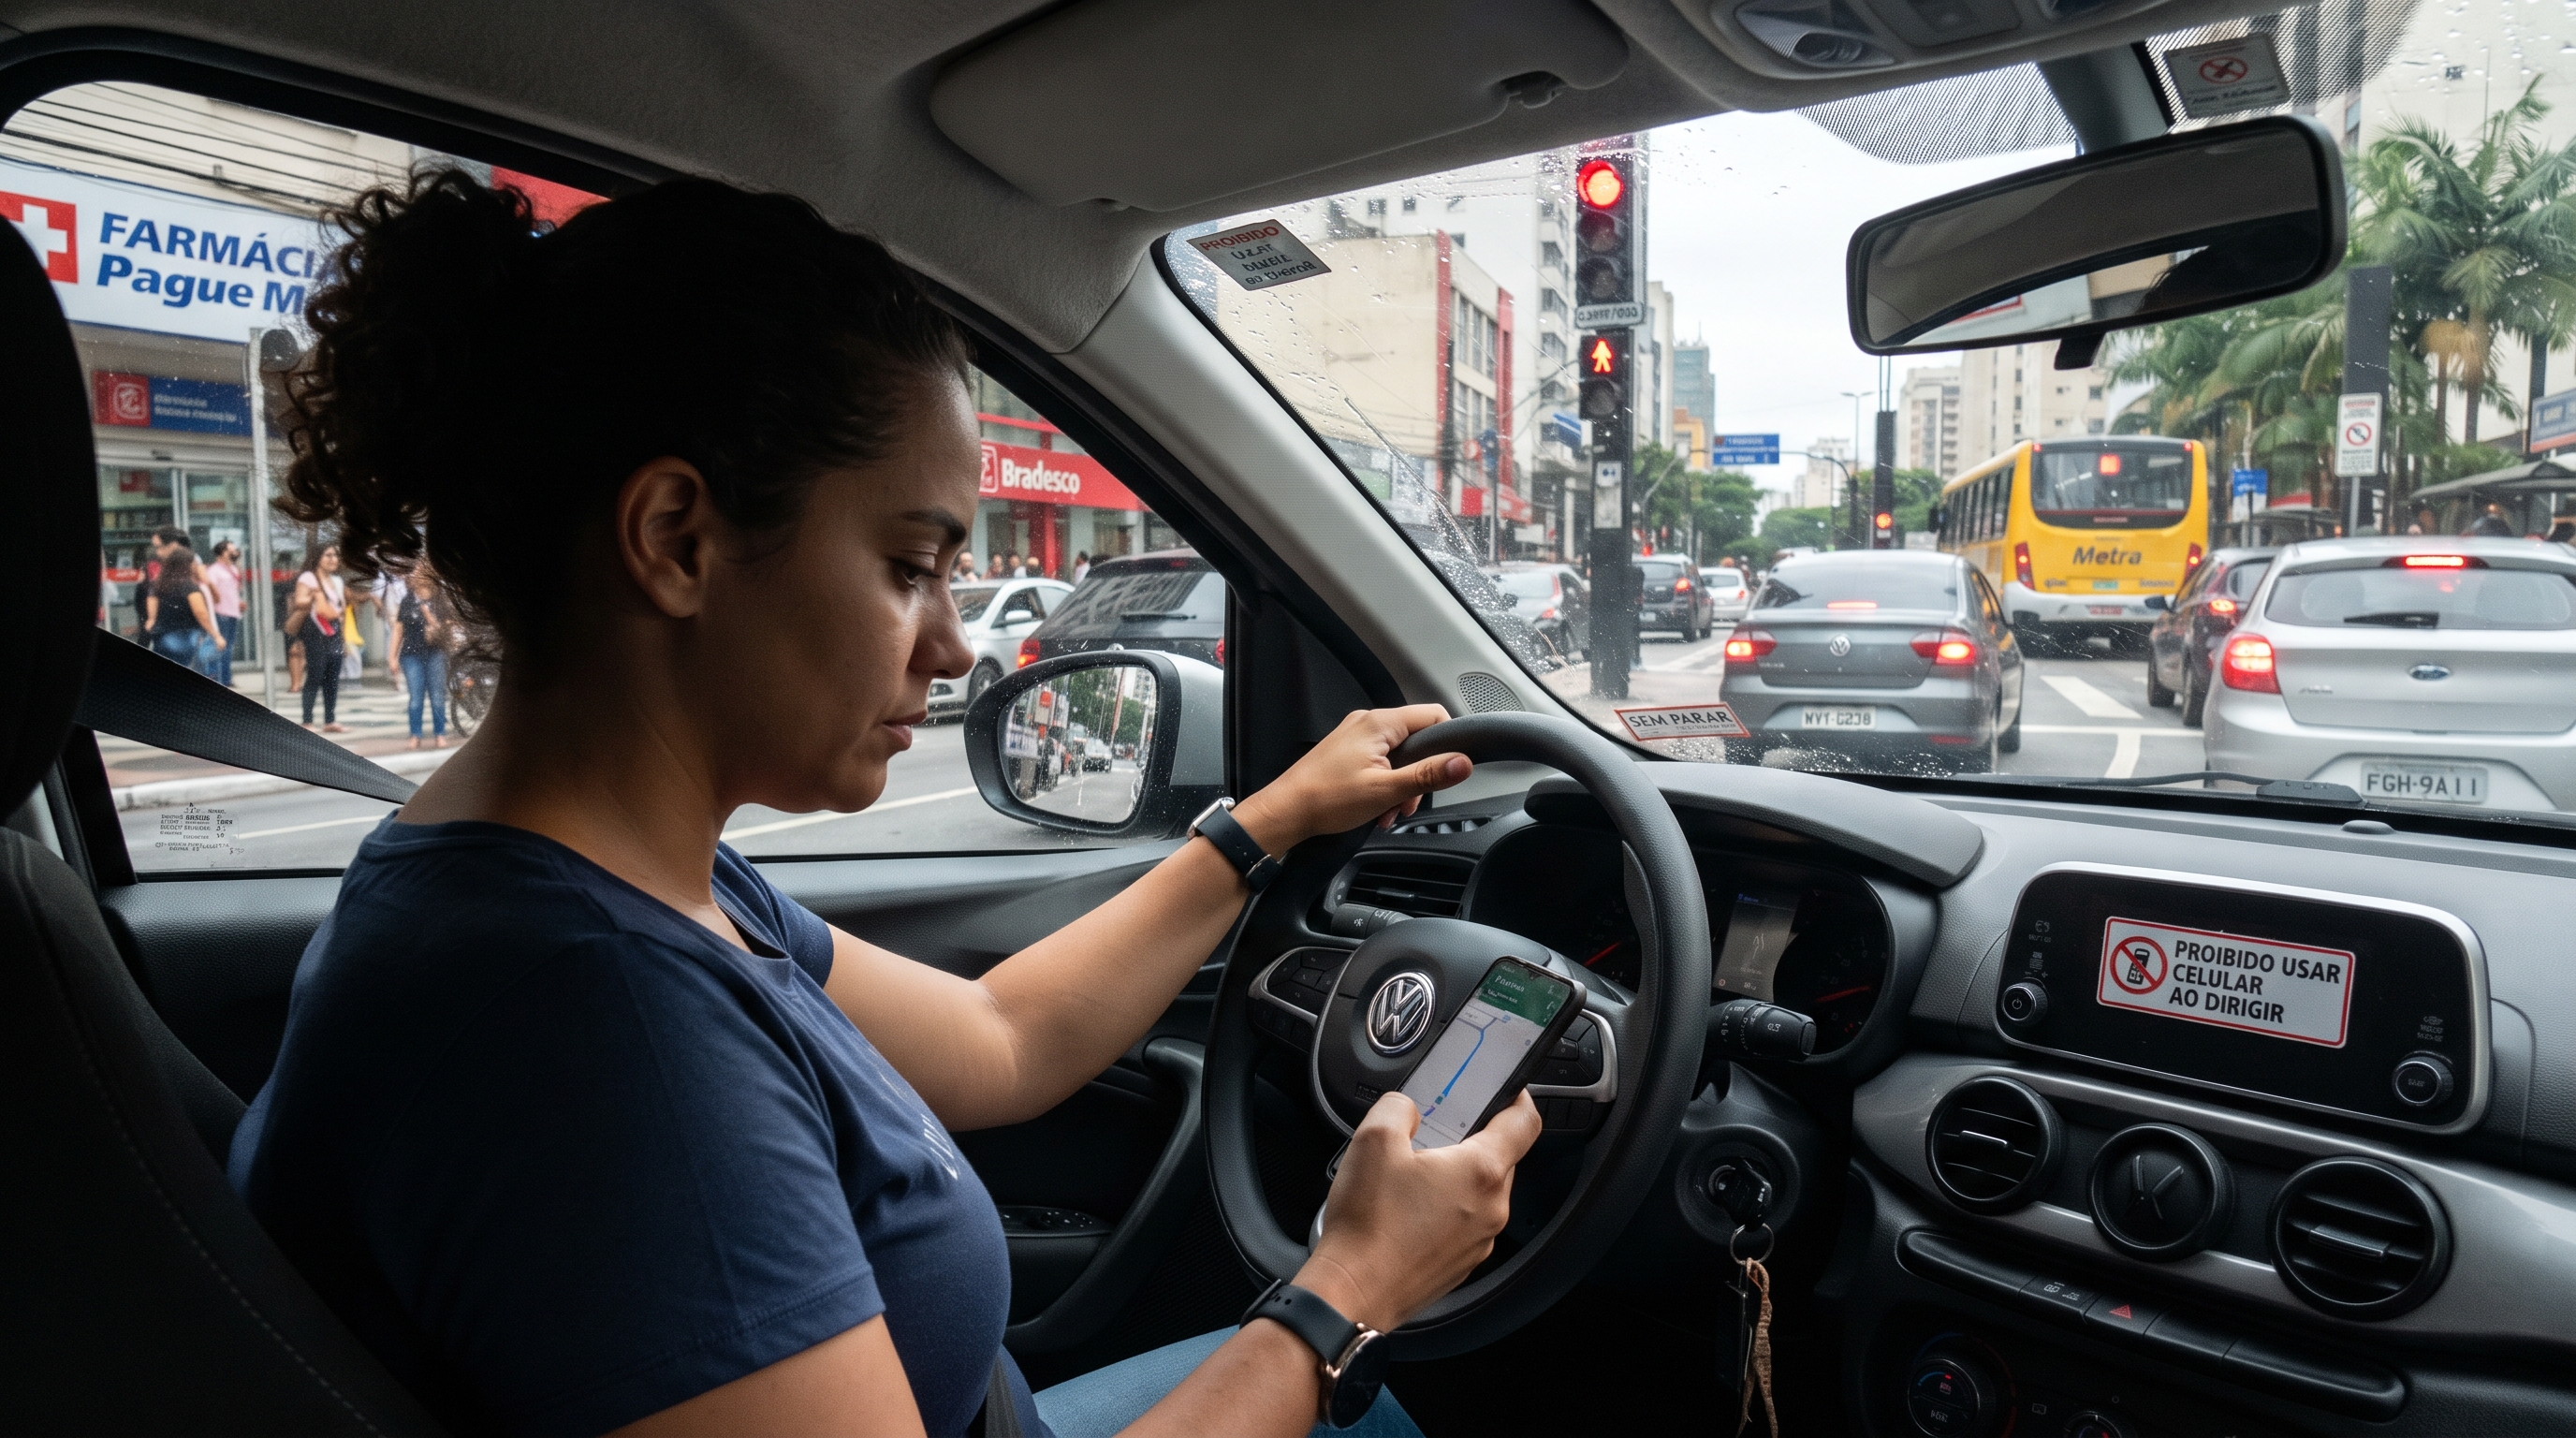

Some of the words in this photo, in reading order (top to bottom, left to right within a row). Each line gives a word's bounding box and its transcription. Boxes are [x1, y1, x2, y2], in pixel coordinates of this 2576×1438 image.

[1199, 226, 1280, 251] PROIBIDO
[96, 253, 254, 309] Pague
[263, 280, 307, 315] M
[1001, 457, 1081, 494] Bradesco
[2072, 546, 2143, 565] Metra
[1629, 714, 1669, 727] SEM
[1669, 711, 1733, 725] PARAR
[2174, 939, 2275, 973] PROIBIDO
[2281, 956, 2341, 984] USAR
[2173, 963, 2263, 996] CELULAR
[2168, 986, 2199, 1008] AO
[2204, 991, 2284, 1024] DIRIGIR
